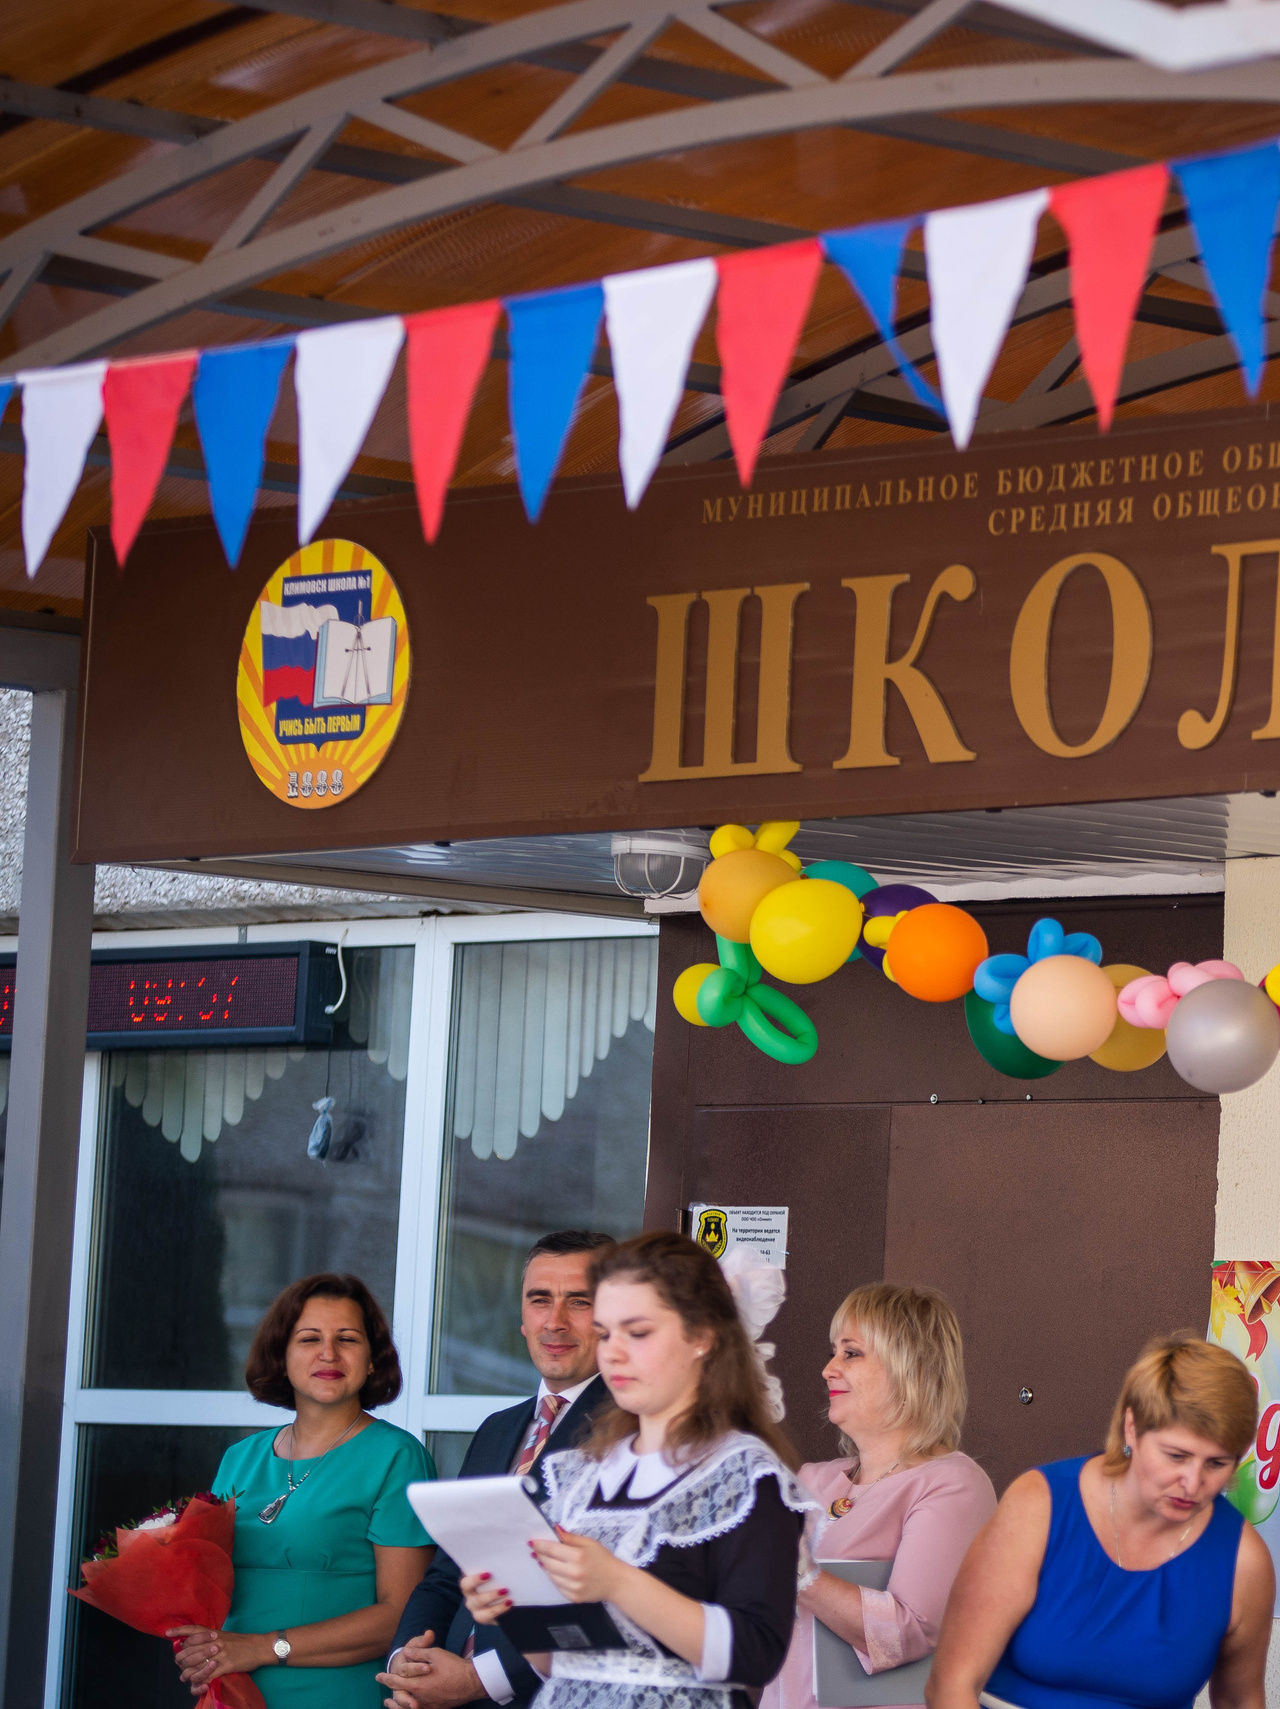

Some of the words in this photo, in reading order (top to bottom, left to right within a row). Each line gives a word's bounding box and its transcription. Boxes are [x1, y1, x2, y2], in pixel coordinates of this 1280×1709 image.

[702, 472, 979, 524] МУНИЦИПАЛЬНОЕ
[996, 450, 1204, 496] БЮДЖЕТНОЕ
[988, 496, 1135, 537] СРЕДНЯЯ
[283, 580, 327, 596] КЛИМОВСК
[327, 576, 357, 592] ШКОЛА
[279, 719, 304, 737] УЧИСЬ
[304, 717, 327, 735] БЫТЬ
[327, 714, 361, 733] ПЕРВЫМ
